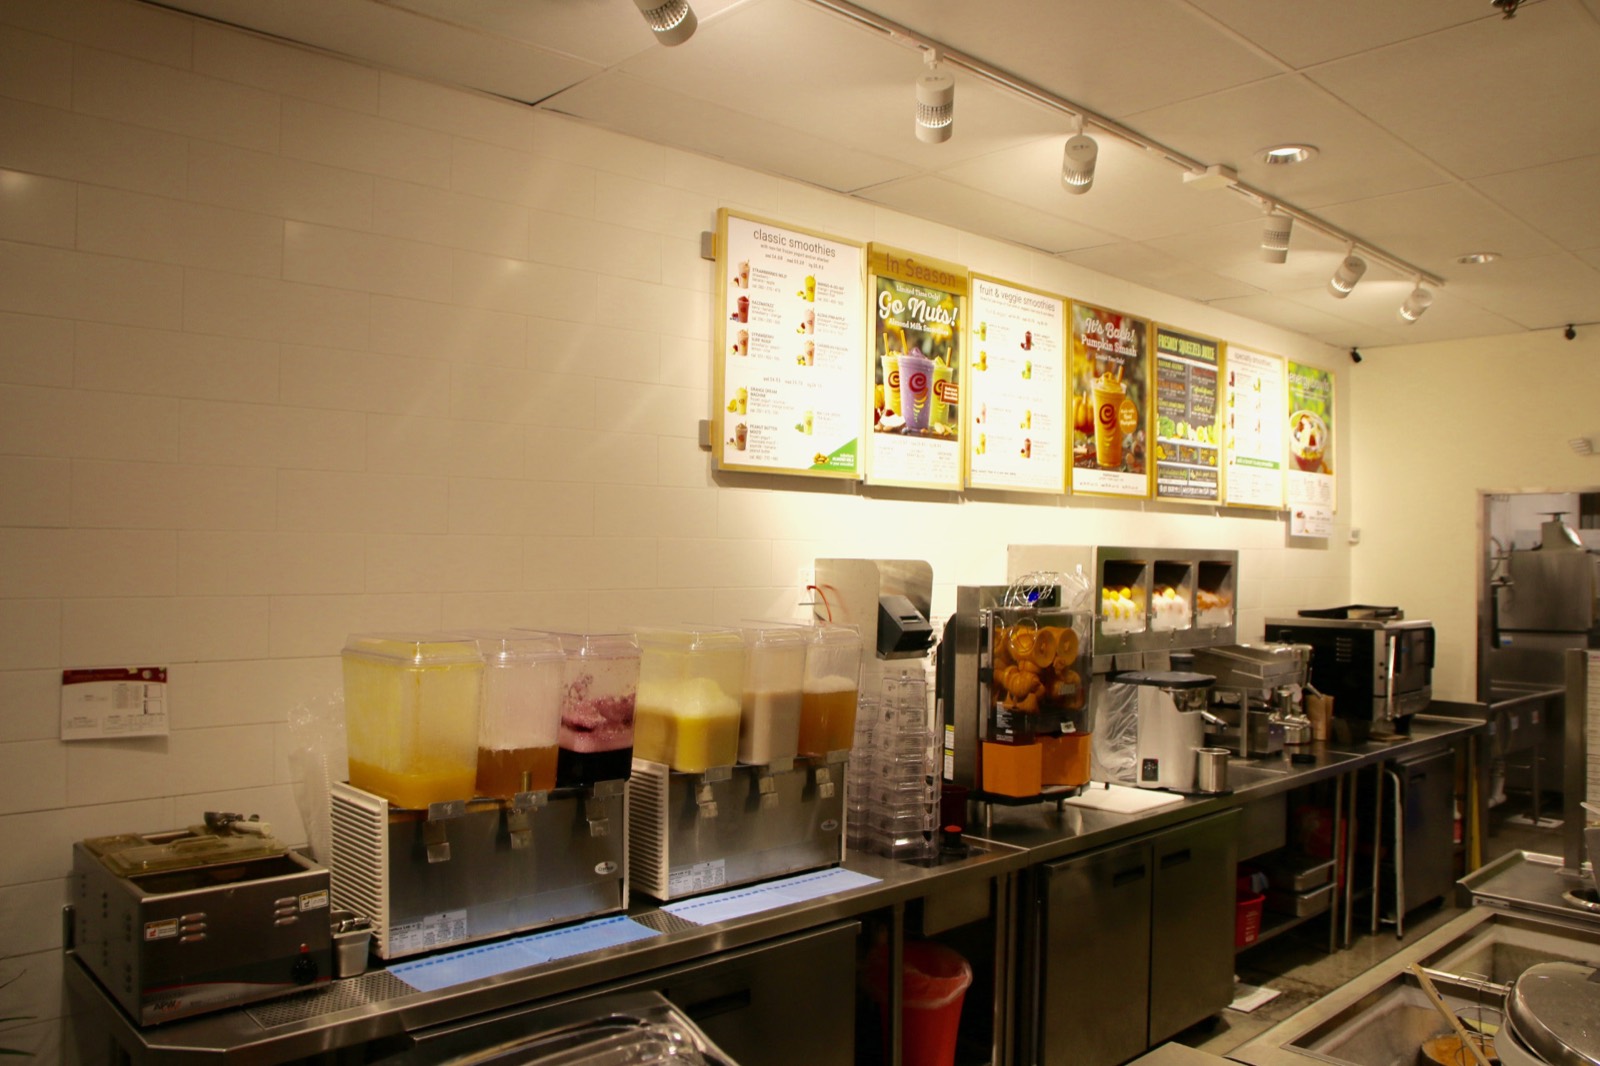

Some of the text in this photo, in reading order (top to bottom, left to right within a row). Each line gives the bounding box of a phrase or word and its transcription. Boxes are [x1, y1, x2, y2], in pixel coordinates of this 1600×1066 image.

[753, 228, 836, 258] classic smoothies
[886, 252, 956, 288] In Season
[896, 285, 940, 301] Limited Time Only!
[979, 284, 994, 297] fruit
[994, 288, 1000, 298] &
[1001, 292, 1022, 304] veggie
[1023, 296, 1056, 312] smoothies
[878, 290, 905, 319] Go
[908, 297, 958, 326] Nuts!
[888, 318, 910, 328] Almond
[910, 322, 922, 330] Milk
[1085, 318, 1136, 342] It's Back!
[1081, 334, 1138, 357] Pumpkin Smash
[1158, 334, 1215, 360] FRESHLY SQUEEZED JUICE
